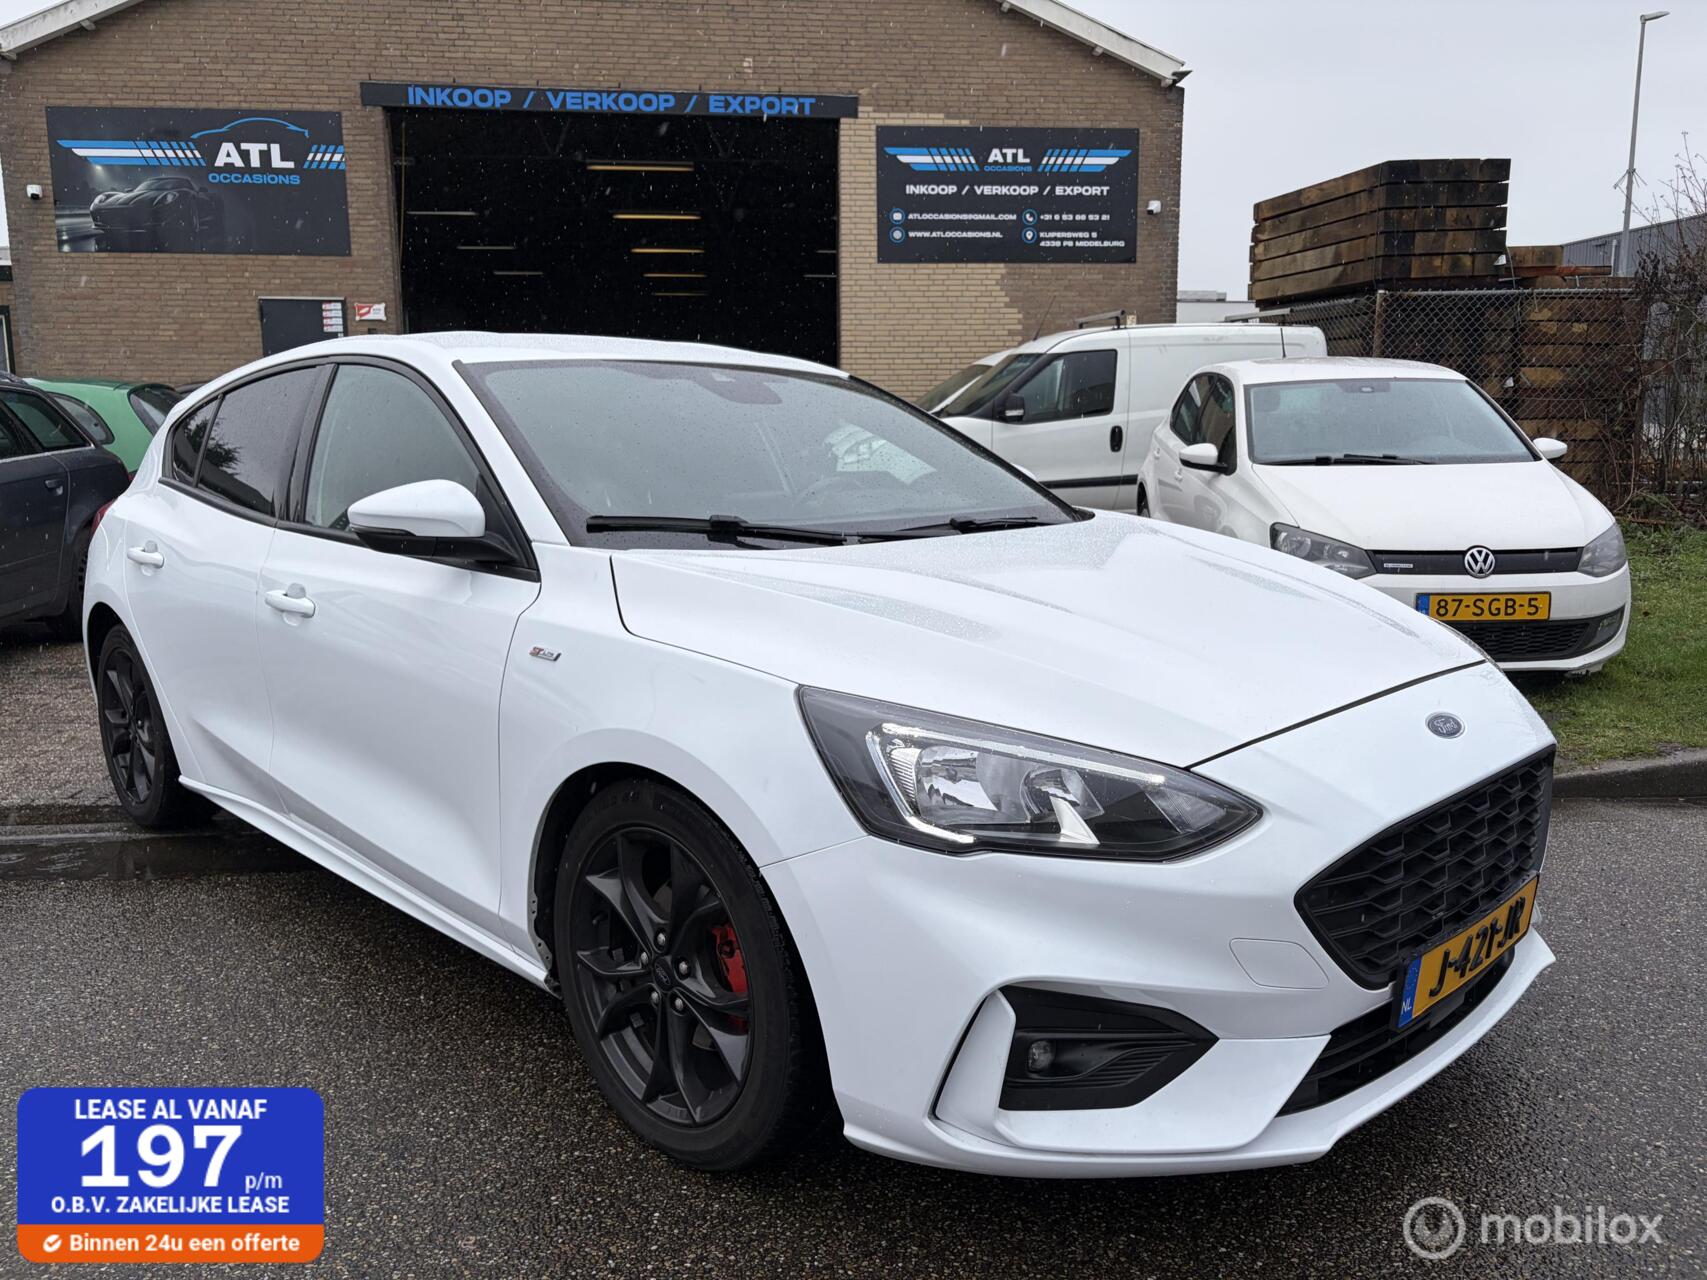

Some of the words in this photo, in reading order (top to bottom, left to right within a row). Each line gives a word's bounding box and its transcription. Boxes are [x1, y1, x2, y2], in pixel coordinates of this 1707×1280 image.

[407, 85, 512, 108] INKOOP
[546, 91, 676, 112] VERKOOP
[709, 95, 816, 115] EXPORT
[214, 142, 295, 168] ATL
[987, 148, 1031, 163] ATL
[208, 172, 301, 185] OCCASIONS
[905, 184, 957, 195] INKOOP
[974, 185, 1039, 196] VERKOOP
[1055, 186, 1110, 196] EXPORT
[1075, 240, 1126, 248] MIDDELBURG
[1436, 598, 1540, 617] 87-SGB-5
[1400, 998, 1413, 1016] NL
